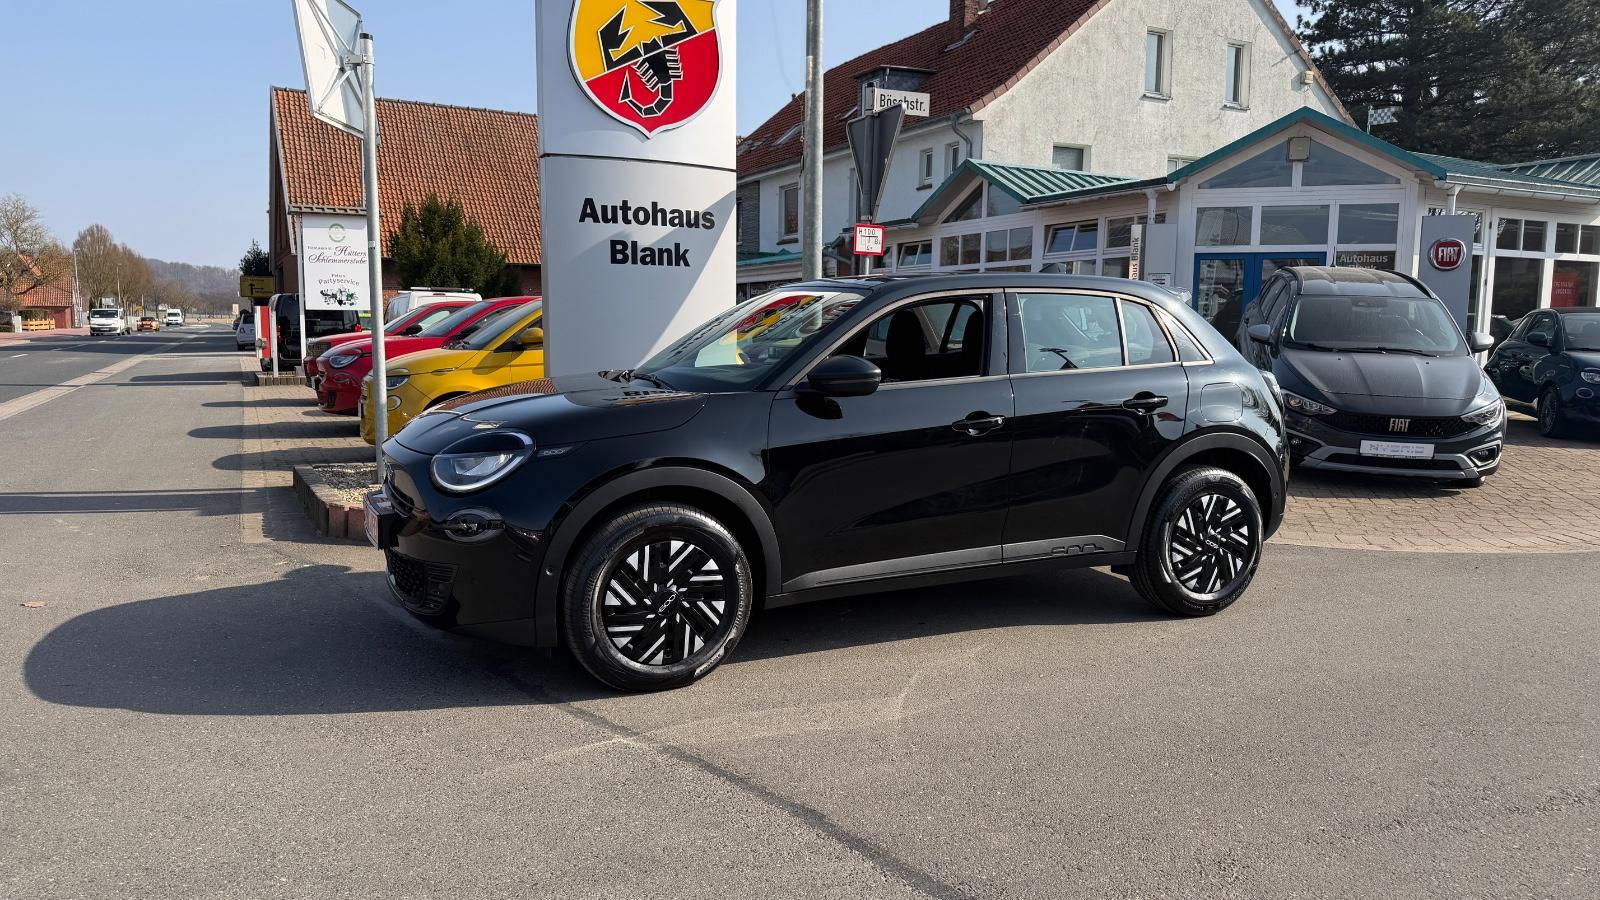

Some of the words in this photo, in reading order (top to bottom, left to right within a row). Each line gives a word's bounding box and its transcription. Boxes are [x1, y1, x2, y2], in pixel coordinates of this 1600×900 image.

[578, 197, 716, 230] Autohaus
[609, 239, 691, 268] Blank
[1131, 237, 1140, 261] Blank
[1339, 253, 1388, 263] Autohaus
[1437, 246, 1460, 262] FIAT
[1388, 417, 1412, 432] FIAT
